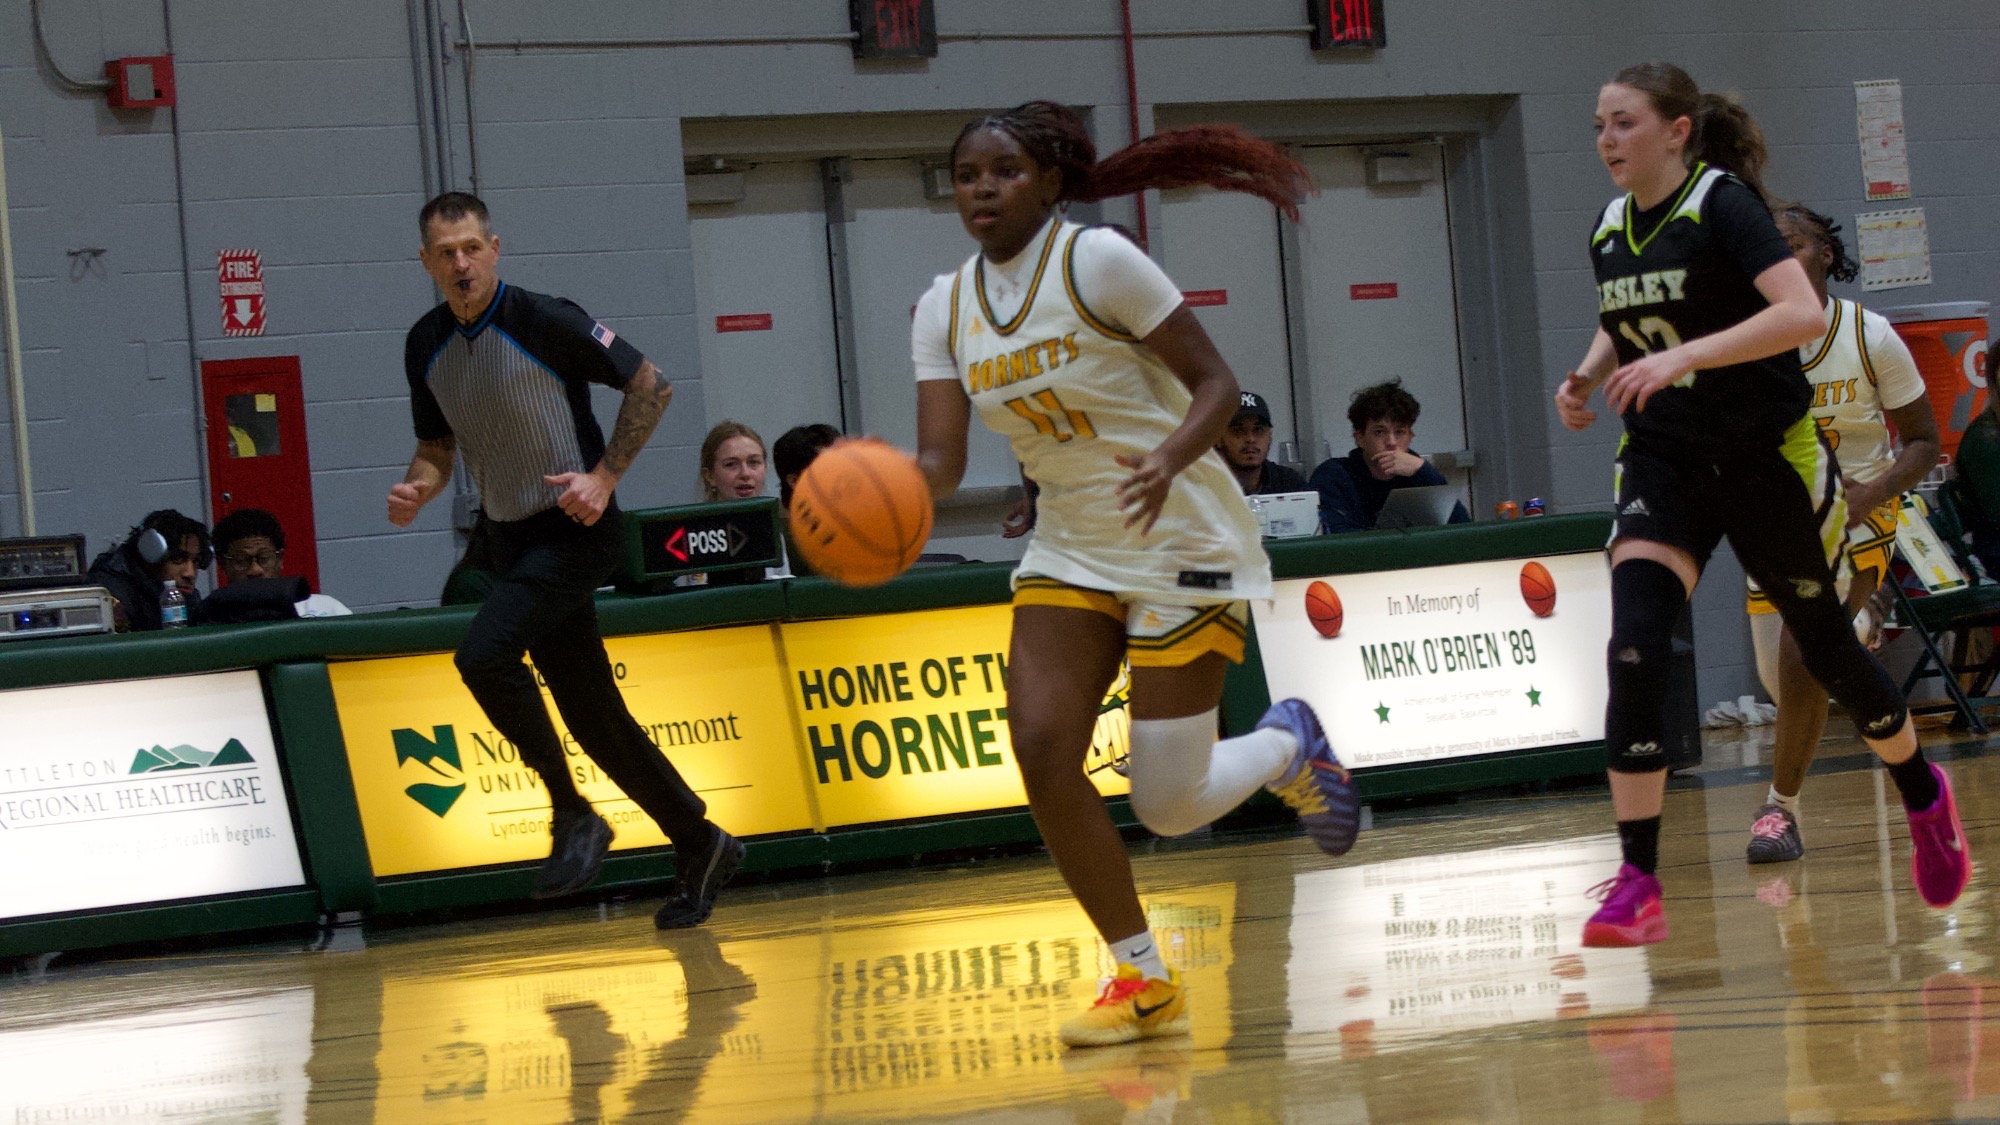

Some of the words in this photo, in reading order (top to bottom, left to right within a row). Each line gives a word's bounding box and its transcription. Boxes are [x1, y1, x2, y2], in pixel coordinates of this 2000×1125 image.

[226, 261, 254, 278] FIRE
[969, 331, 1080, 395] HORNETS
[1811, 378, 1858, 408] ETS
[688, 529, 728, 555] POSS
[1387, 596, 1403, 616] In
[1406, 593, 1463, 616] Memory
[1468, 588, 1481, 613] of
[1360, 642, 1422, 681] MARK
[1423, 632, 1501, 674] O'BRIEN
[1502, 628, 1537, 665] '89
[799, 662, 914, 710] HOME
[920, 656, 967, 699] OF
[807, 707, 1008, 784] HORNE
[116, 776, 267, 810] HEALTHCARE
[227, 823, 276, 848] begins.
